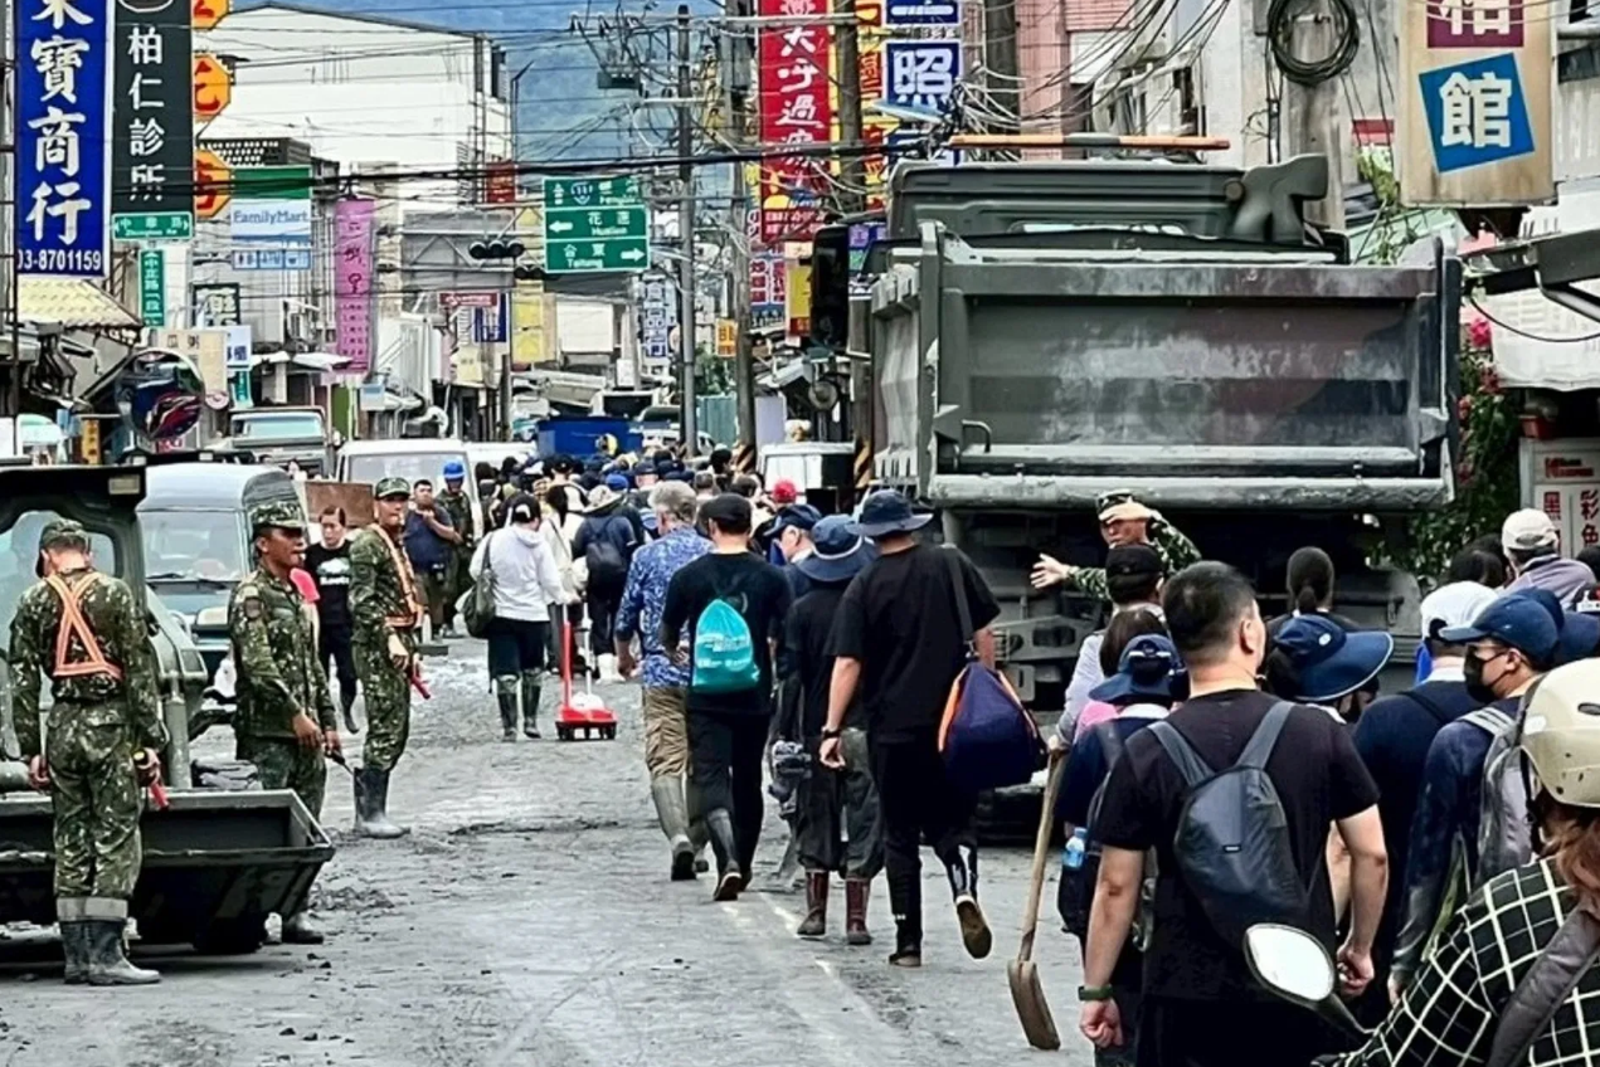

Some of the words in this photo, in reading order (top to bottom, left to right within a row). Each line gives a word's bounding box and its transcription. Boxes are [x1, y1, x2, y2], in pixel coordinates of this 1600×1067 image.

[128, 26, 166, 201] 柏仁診所
[233, 210, 309, 225] FamilyMart
